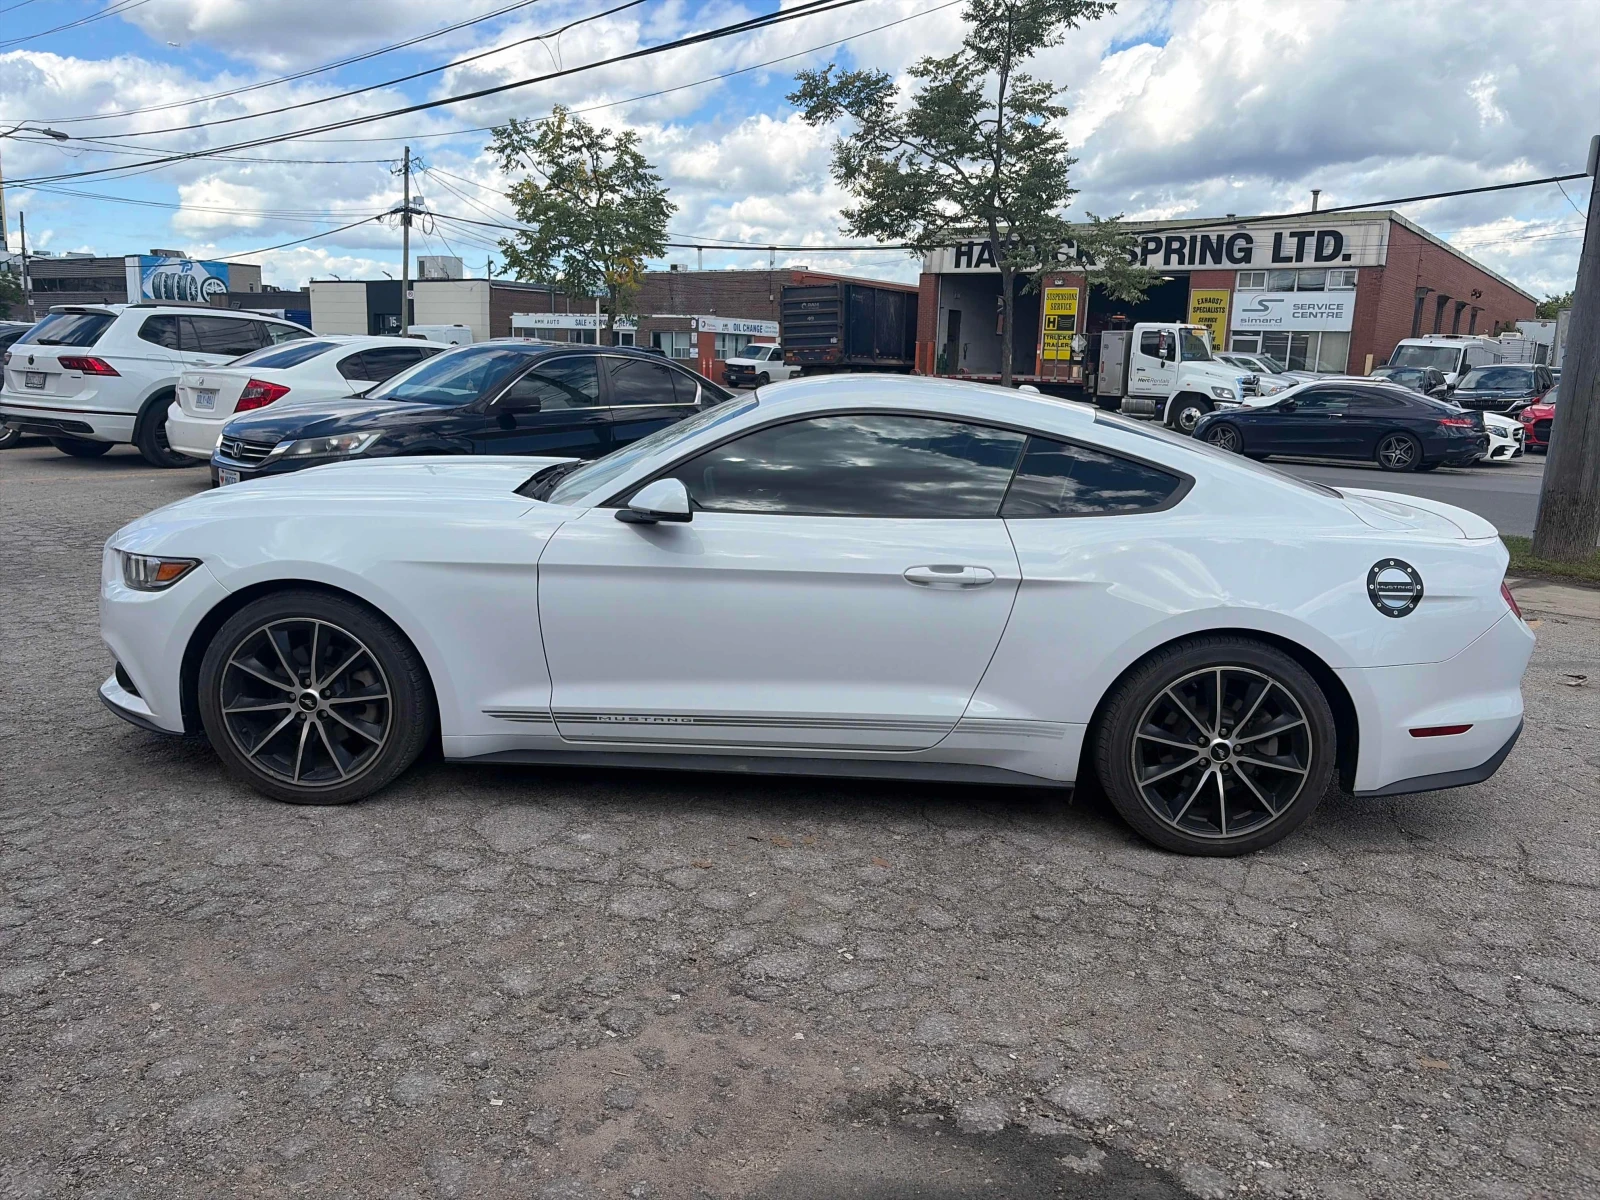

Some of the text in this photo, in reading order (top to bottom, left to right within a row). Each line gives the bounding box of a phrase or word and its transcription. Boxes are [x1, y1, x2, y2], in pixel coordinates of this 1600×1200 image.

[1271, 230, 1352, 263] LTD.
[1197, 297, 1223, 305] EXHAUST
[1050, 302, 1072, 311] SERVICE
[390, 317, 396, 326] 15
[691, 320, 697, 328] 9
[733, 323, 741, 332] OIL
[743, 324, 763, 333] CHANGE
